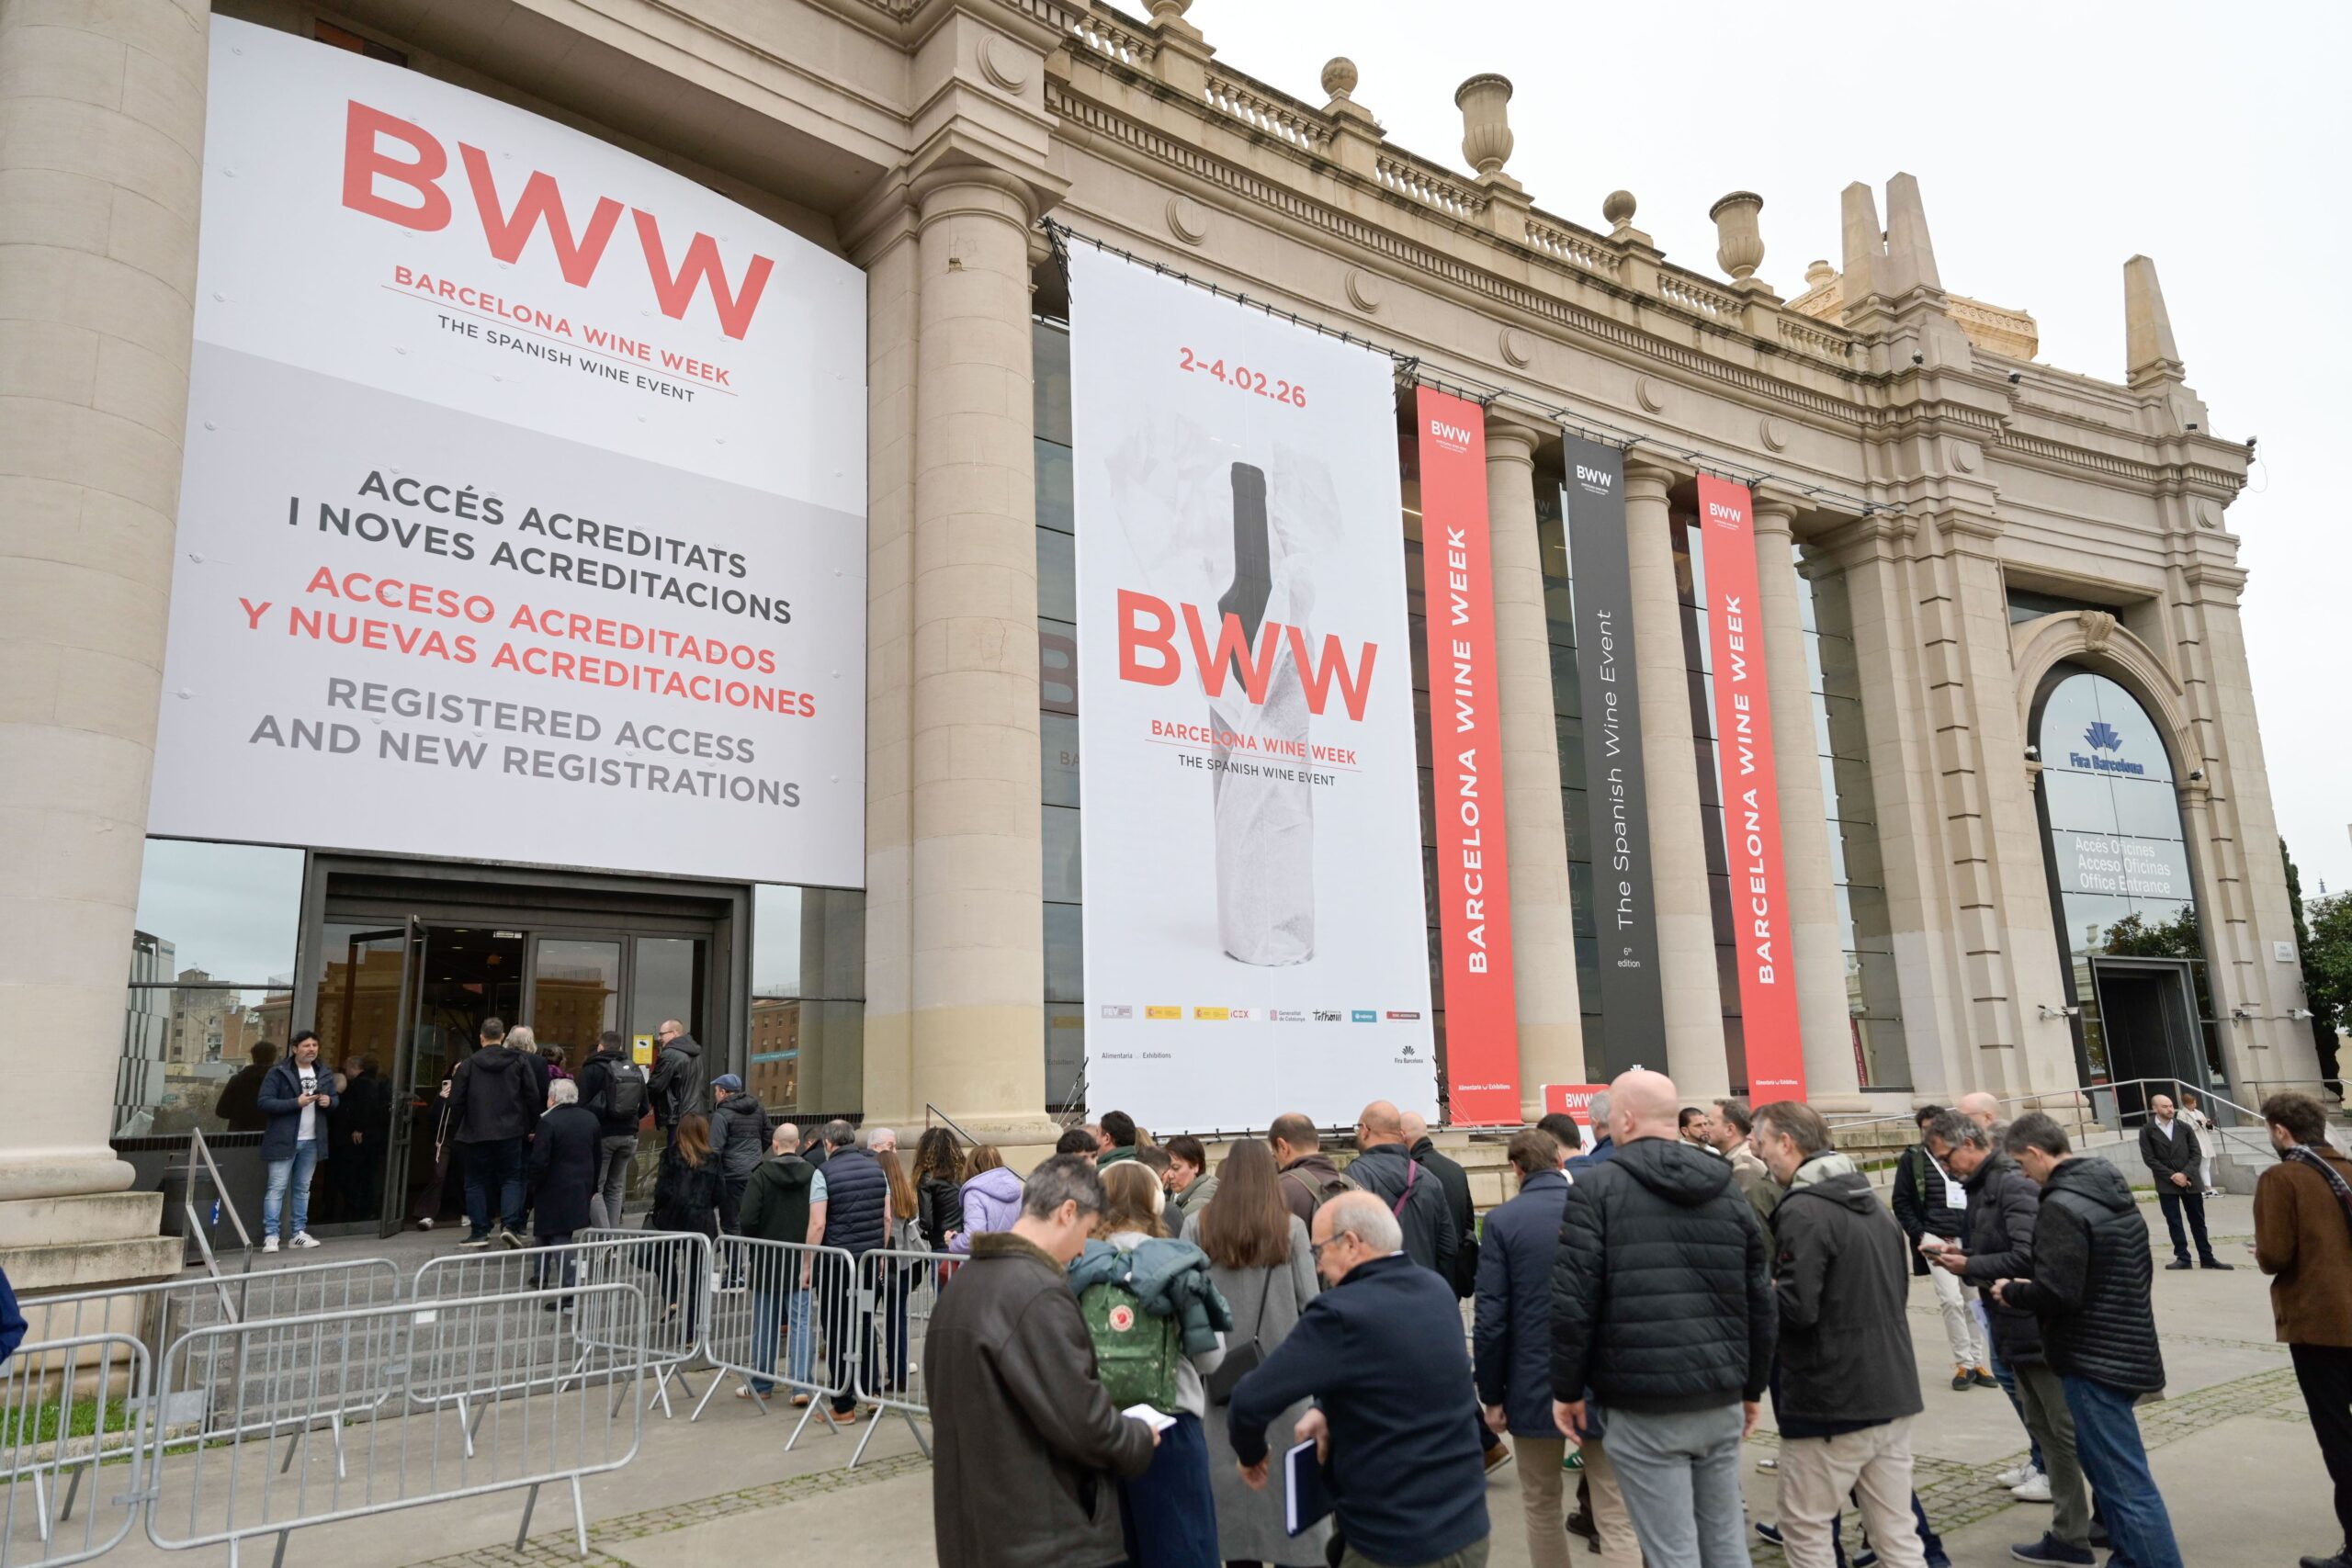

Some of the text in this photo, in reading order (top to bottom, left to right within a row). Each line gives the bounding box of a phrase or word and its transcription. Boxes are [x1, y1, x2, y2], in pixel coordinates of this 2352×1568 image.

[342, 99, 775, 341] BWW
[394, 265, 731, 388] BARCELONA WINE WEEK
[438, 314, 695, 403] THE SPANISH WINE EVENT
[1178, 346, 1307, 409] 2-4.02.26
[1430, 419, 1471, 445] BWW
[1576, 463, 1612, 488] BWW
[356, 469, 748, 580] ACCÉS ACREDITATS
[1709, 502, 1742, 523] BWW
[288, 496, 793, 626] I NOVES ACREDITACIONS
[239, 598, 817, 718] Y NUEVAS ACREDITACIONES
[306, 566, 777, 675] ACCESO ACREDITADOS
[1116, 588, 1378, 723] BWW
[248, 715, 801, 808] AND NEW REGISTRATIONS
[327, 677, 756, 764] REGISTERED ACCESS
[1151, 719, 1358, 766] BARCELONA WINE WEEK
[1447, 525, 1487, 974] BARCELONA WINE WEEK
[2070, 751, 2144, 775] Fira Barcelona
[1178, 754, 1336, 787] THE SPANISH WINE EVENT
[1596, 609, 1634, 931] The Spanish Wine Event
[1725, 593, 1775, 985] BARCELONA WINE WEEK
[2075, 836, 2109, 854] Accés
[2078, 853, 2172, 876] Acceso Oficinas
[2079, 873, 2171, 895] Office Entrance
[1617, 958, 1641, 968] edition
